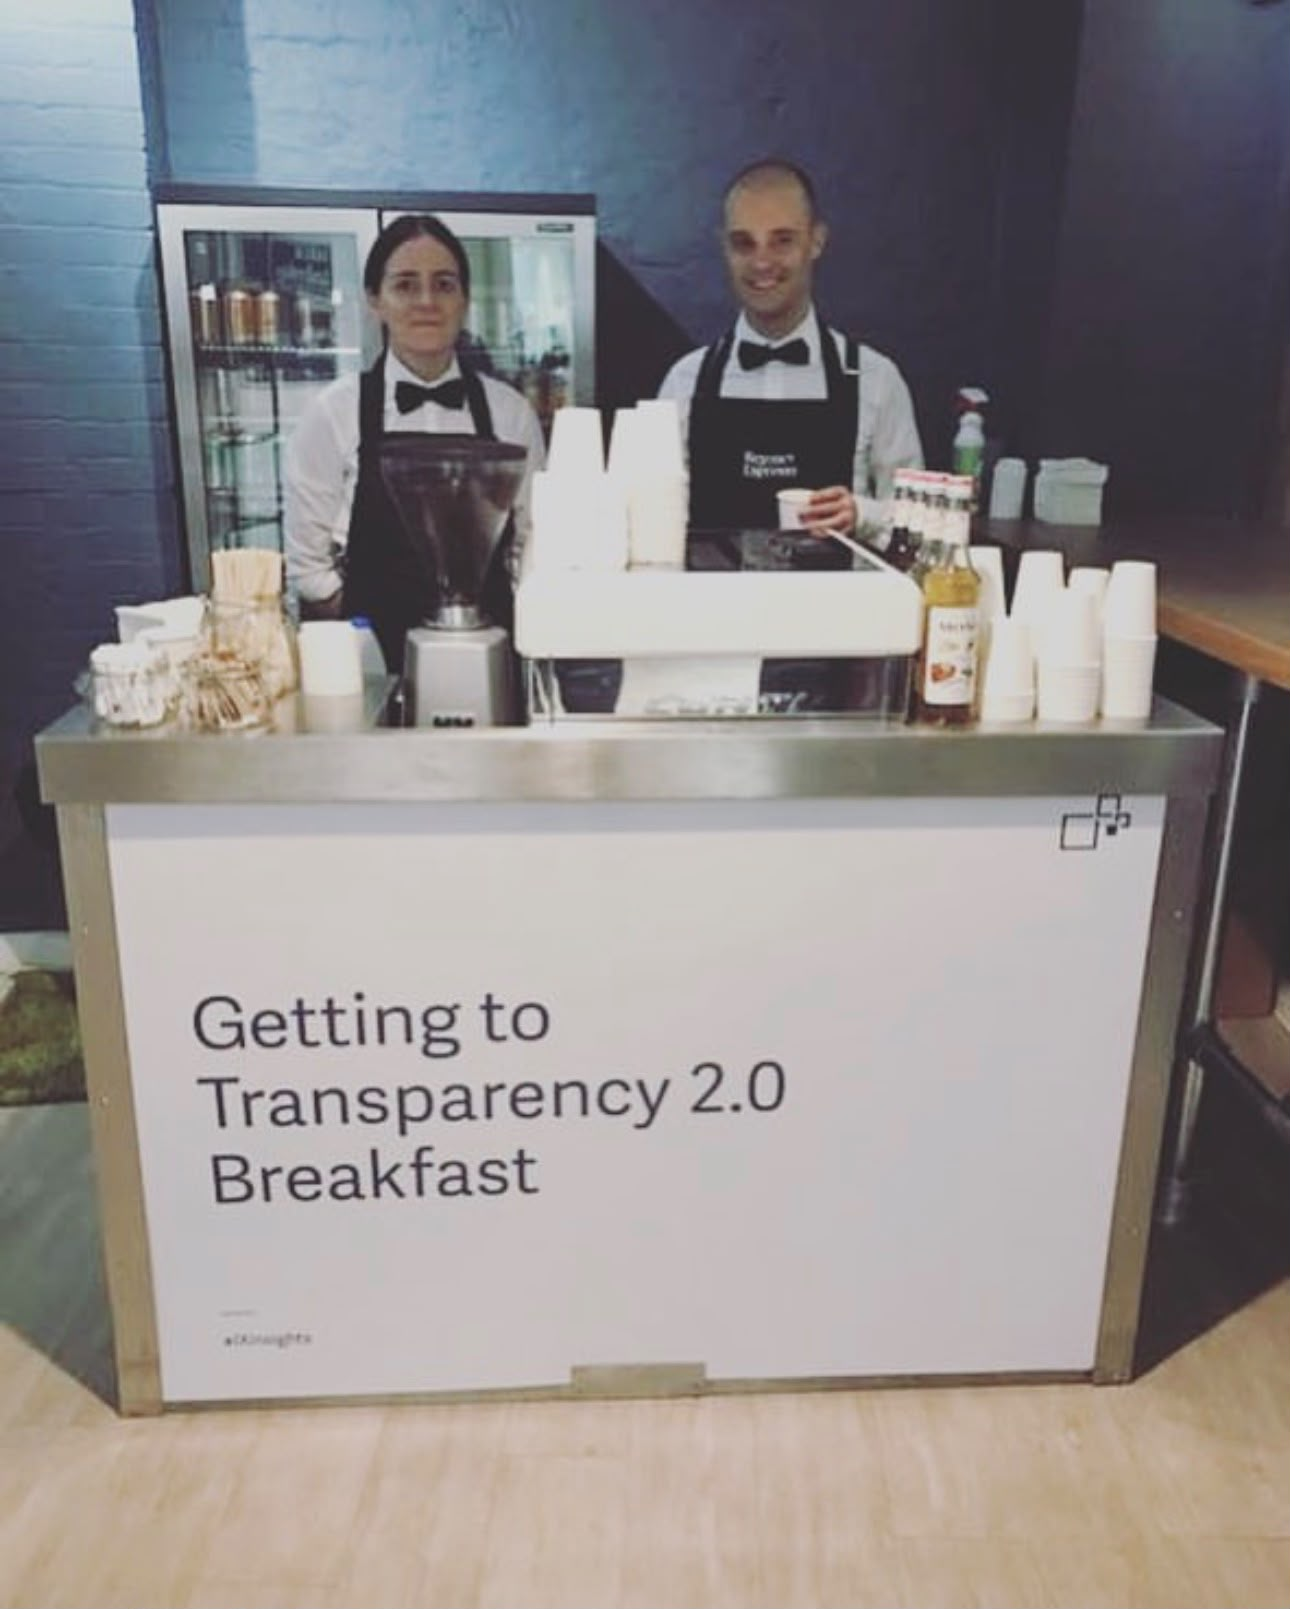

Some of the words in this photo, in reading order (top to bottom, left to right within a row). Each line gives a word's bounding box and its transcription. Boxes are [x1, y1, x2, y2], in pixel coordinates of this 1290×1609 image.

[192, 992, 461, 1059] Getting
[478, 992, 550, 1043] to
[196, 1075, 671, 1137] Transparency
[689, 1060, 786, 1114] 2.0
[211, 1145, 540, 1204] Breakfast
